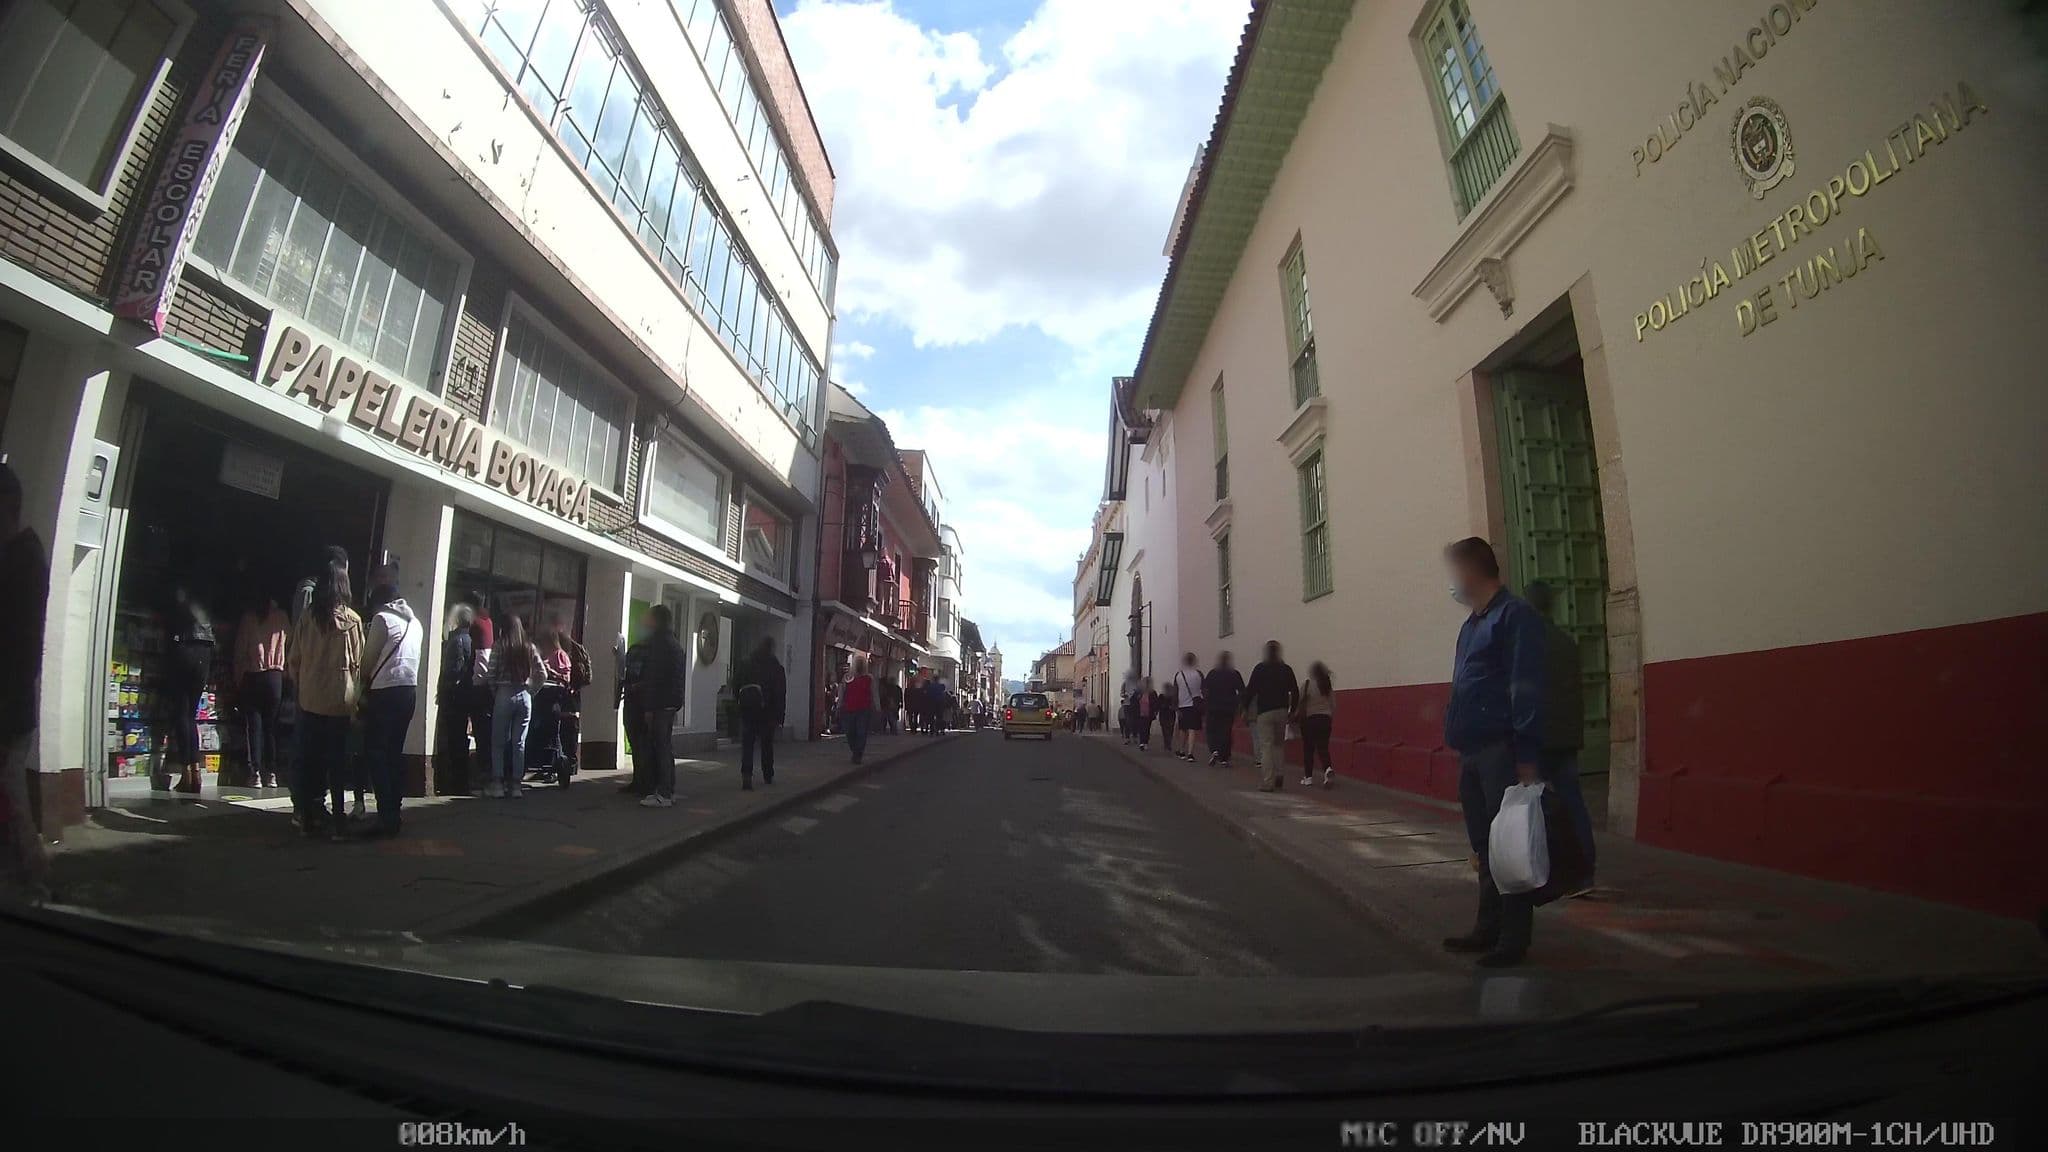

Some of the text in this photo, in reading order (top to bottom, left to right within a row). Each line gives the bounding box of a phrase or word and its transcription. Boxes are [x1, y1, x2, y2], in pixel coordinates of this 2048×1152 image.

[196, 35, 257, 125] FERIA
[1631, 81, 1719, 178] POLICÍA
[132, 142, 206, 290] ESCOLAR
[1633, 80, 1988, 342] POLICÍA METROPOLITANA
[1735, 227, 1885, 338] DE TUNJA
[261, 326, 483, 478] PAPELERÍA
